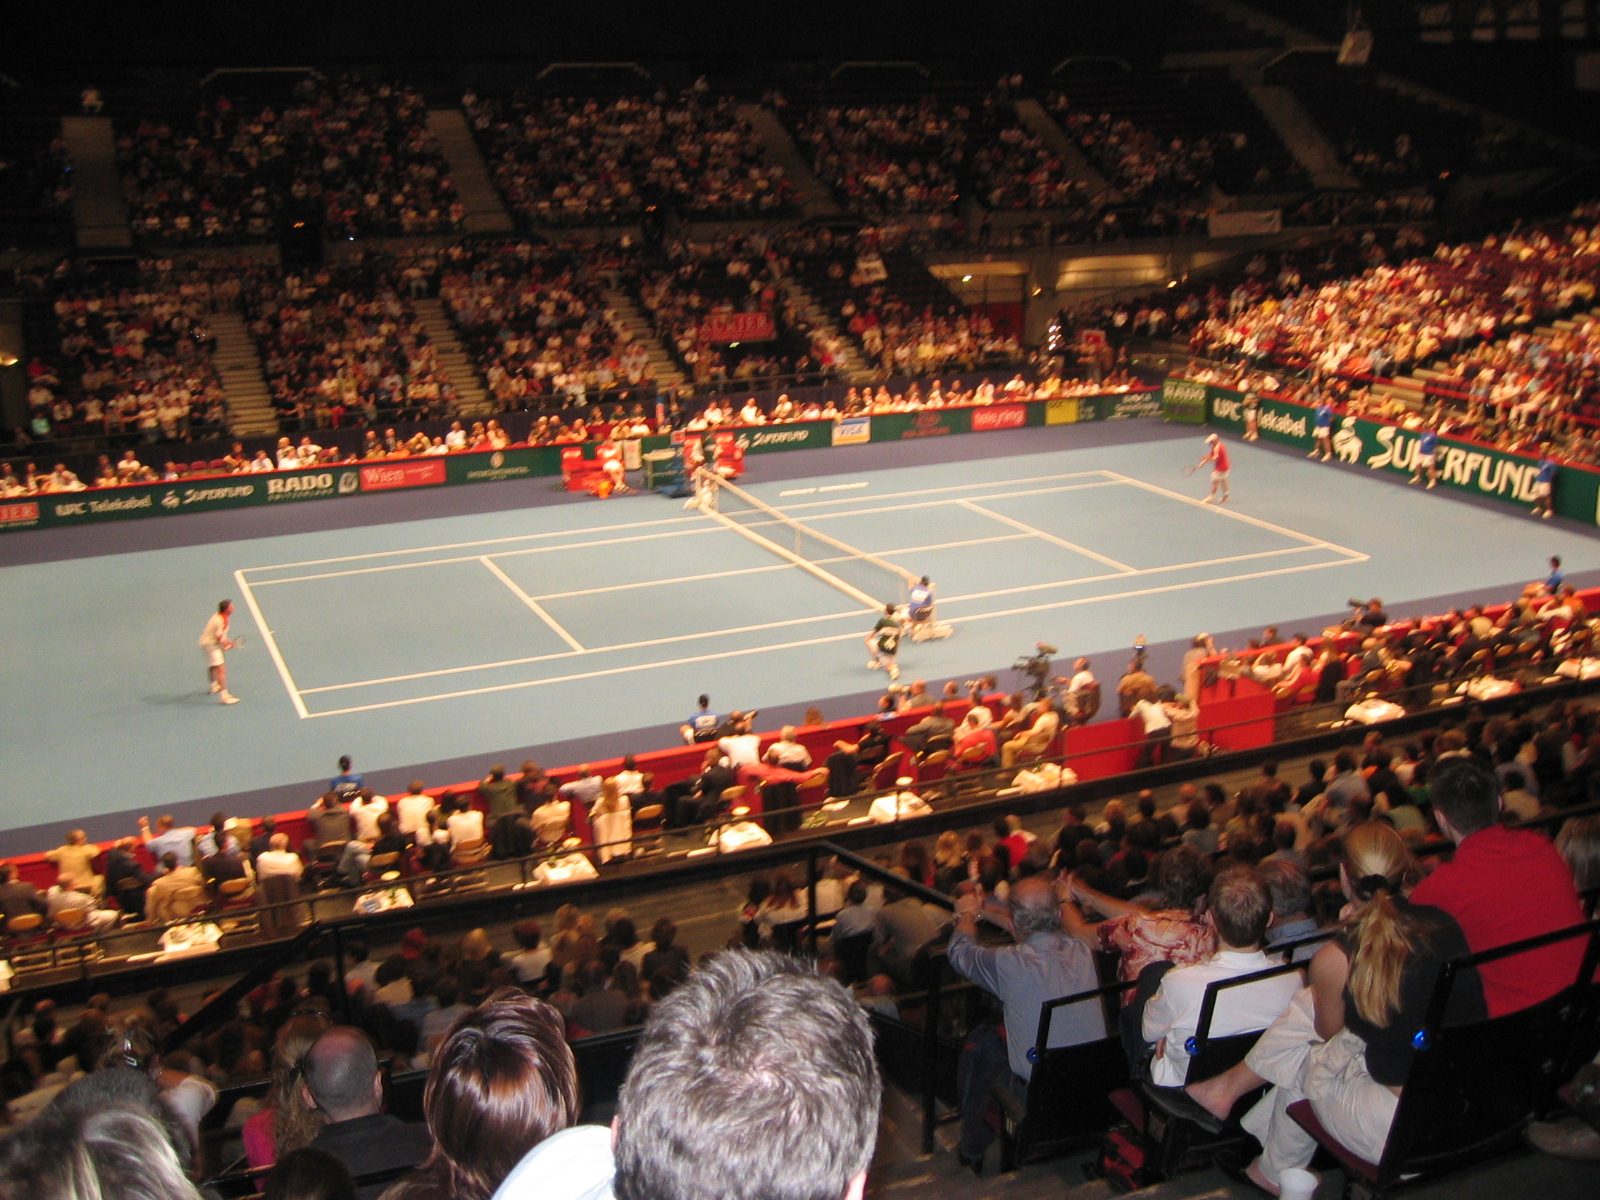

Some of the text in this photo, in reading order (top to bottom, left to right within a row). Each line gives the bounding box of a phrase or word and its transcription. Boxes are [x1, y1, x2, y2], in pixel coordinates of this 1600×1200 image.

[1213, 398, 1242, 421] UPC
[1258, 407, 1306, 437] lekabel
[751, 430, 809, 448] SUPERFUND
[1367, 426, 1541, 501] SUPRFUND
[267, 473, 333, 494] RADO
[55, 494, 153, 517] UPC Telekabel
[182, 485, 255, 505] SUPERFUND
